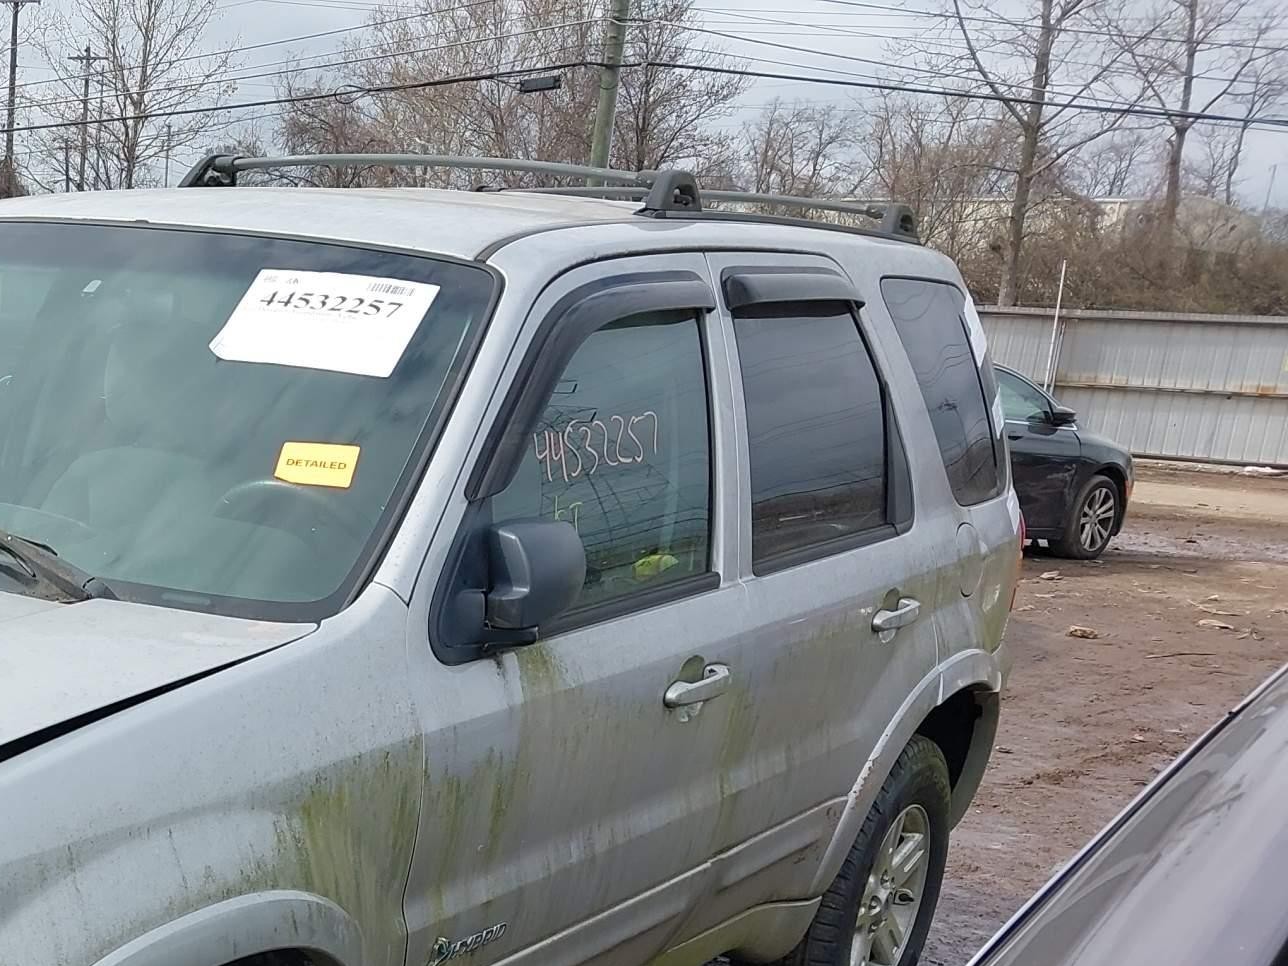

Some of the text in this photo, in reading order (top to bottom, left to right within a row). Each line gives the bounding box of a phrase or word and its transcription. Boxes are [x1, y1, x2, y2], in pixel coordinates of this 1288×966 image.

[259, 290, 404, 318] 44532257
[533, 411, 659, 482] 44532257
[285, 458, 347, 470] DETAILED
